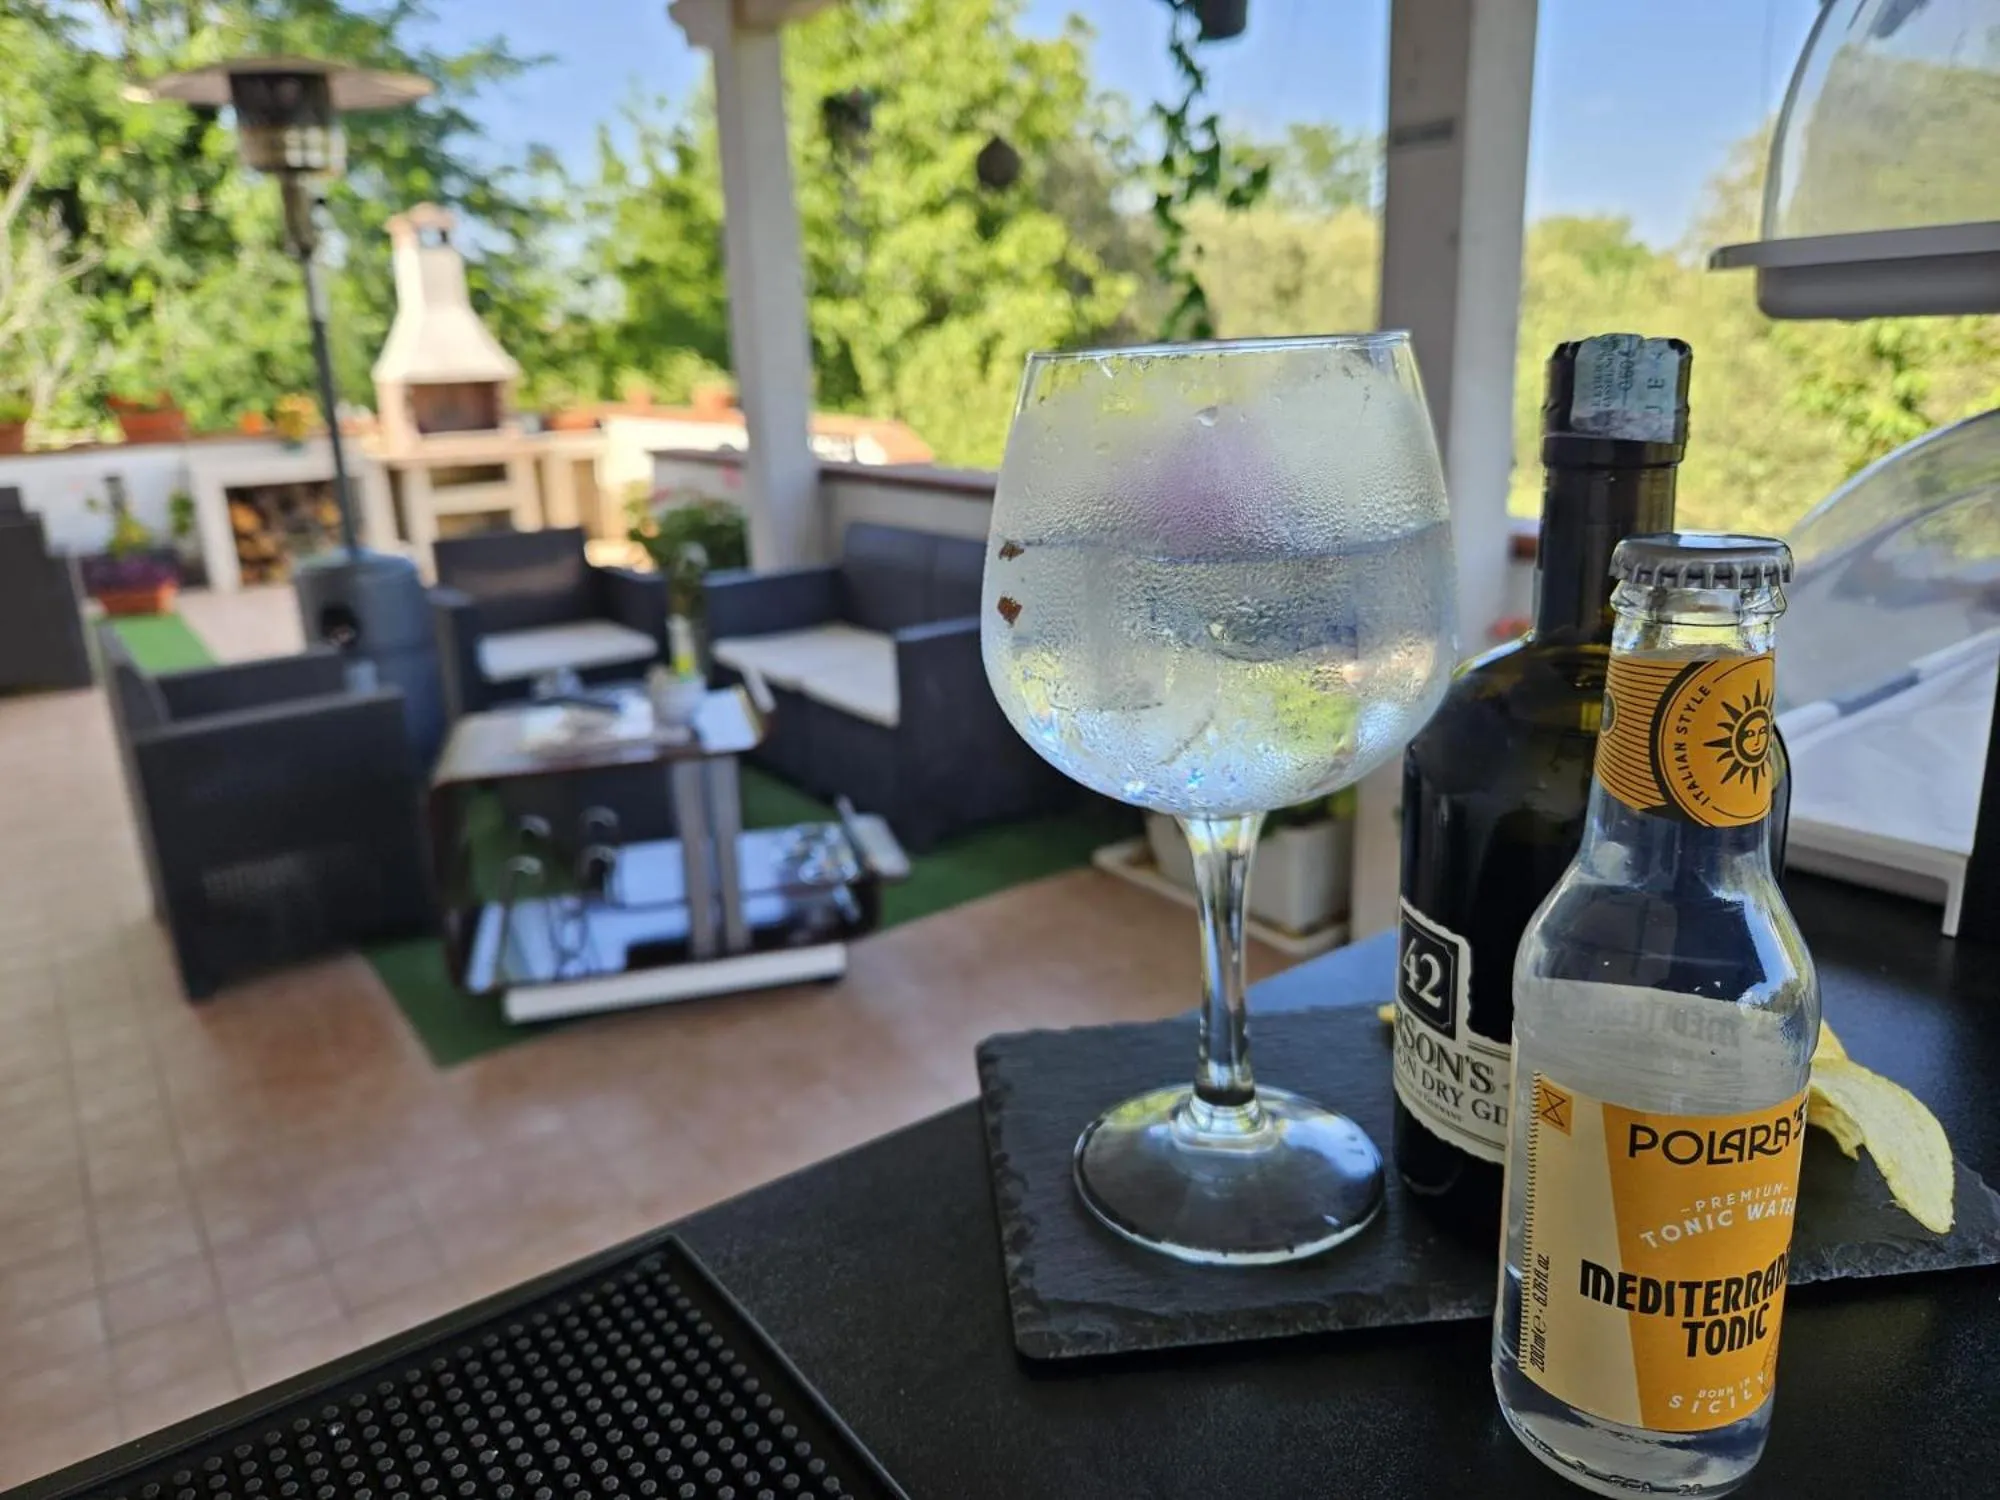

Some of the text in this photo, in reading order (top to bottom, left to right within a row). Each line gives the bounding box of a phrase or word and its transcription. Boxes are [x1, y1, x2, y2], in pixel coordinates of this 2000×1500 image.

[1674, 685, 1712, 806] ITALIAN STYLE
[1403, 937, 1442, 1008] 42
[1422, 1069, 1464, 1108] DRY
[1629, 1096, 1808, 1166] POLARA'S
[1639, 1197, 1795, 1249] TONIC WATE
[1682, 1302, 1770, 1358] TONIC
[1668, 1372, 1764, 1414] SICILY
